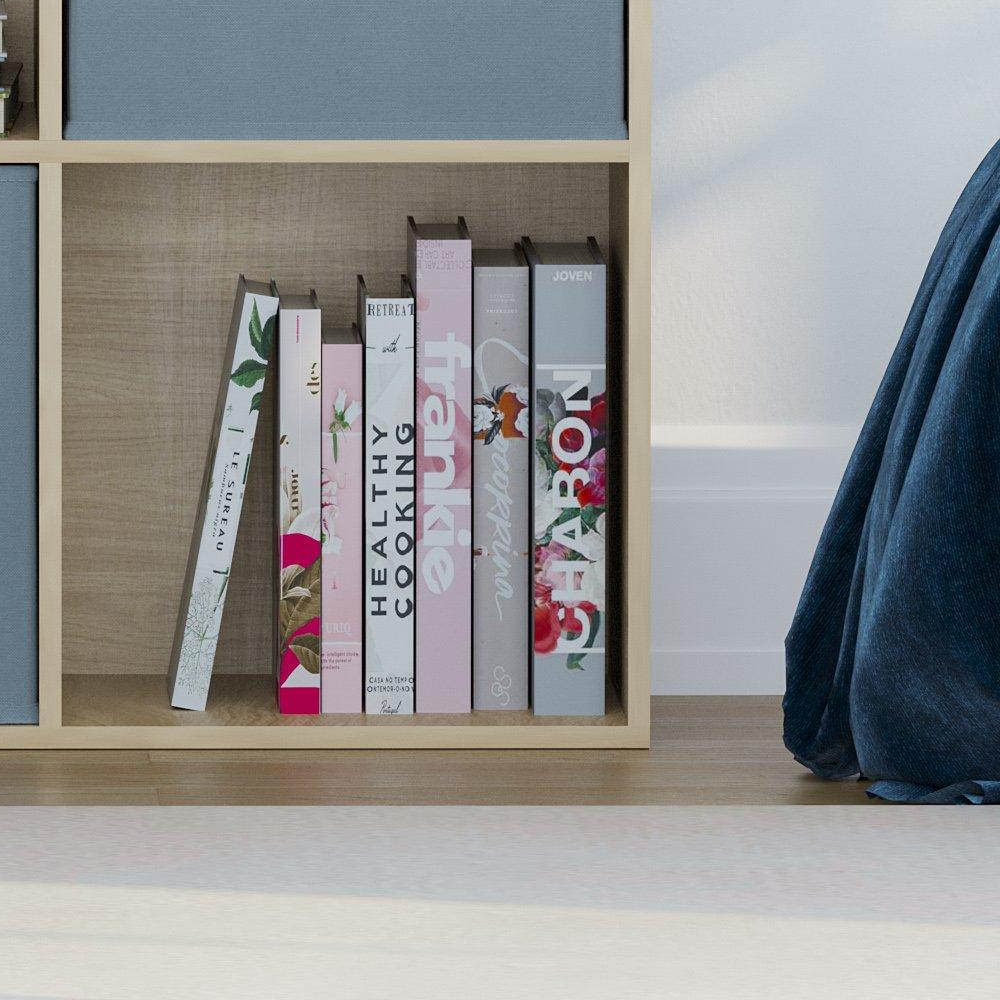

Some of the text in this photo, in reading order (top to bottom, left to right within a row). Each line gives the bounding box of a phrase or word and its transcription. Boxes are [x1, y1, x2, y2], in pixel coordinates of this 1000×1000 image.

[367, 303, 414, 316] RETREAT
[553, 270, 592, 282] JOVEN
[216, 451, 240, 551] LE SUREAU
[371, 424, 388, 616] HEALTHY
[394, 423, 414, 618] COOKING
[421, 332, 472, 595] frankie
[552, 370, 592, 653] CHABON
